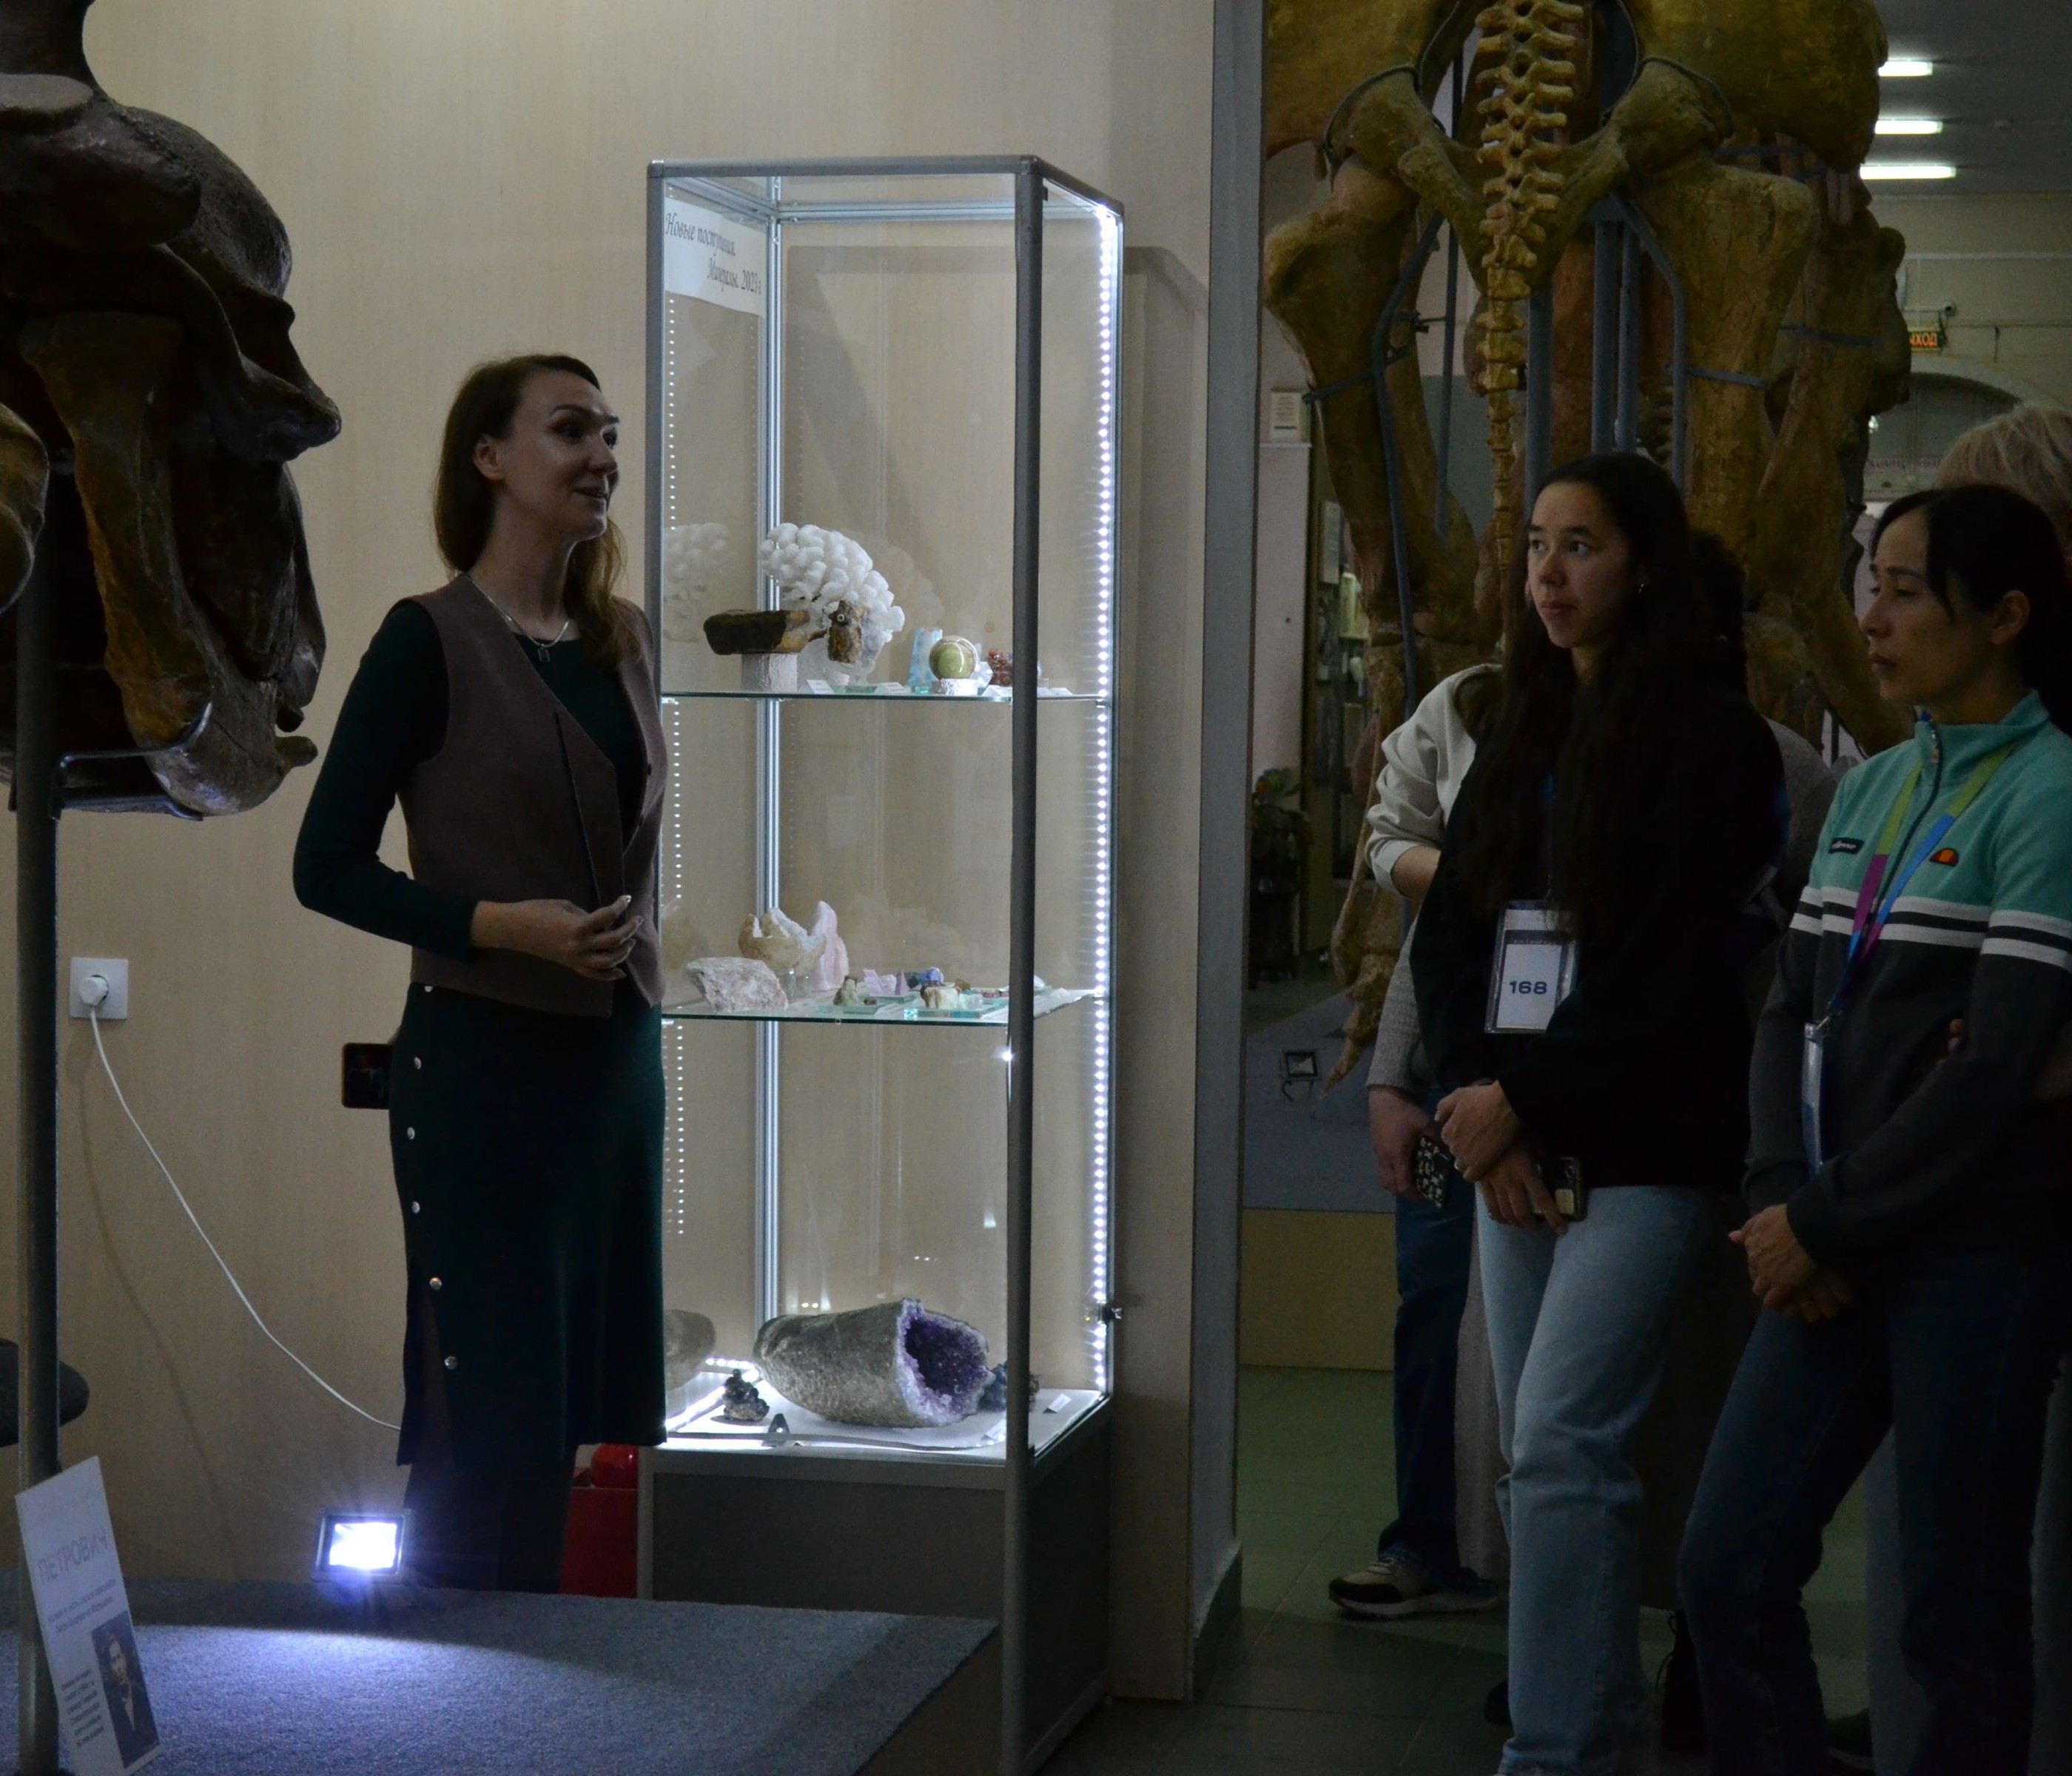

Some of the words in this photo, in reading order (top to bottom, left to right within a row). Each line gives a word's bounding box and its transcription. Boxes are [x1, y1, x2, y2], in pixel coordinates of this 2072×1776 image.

[665, 212, 695, 241] Новые
[1910, 332, 1937, 347] ЫХОД
[1510, 980, 1547, 995] 168
[38, 1530, 108, 1586] ПЕТРОВИЧ
